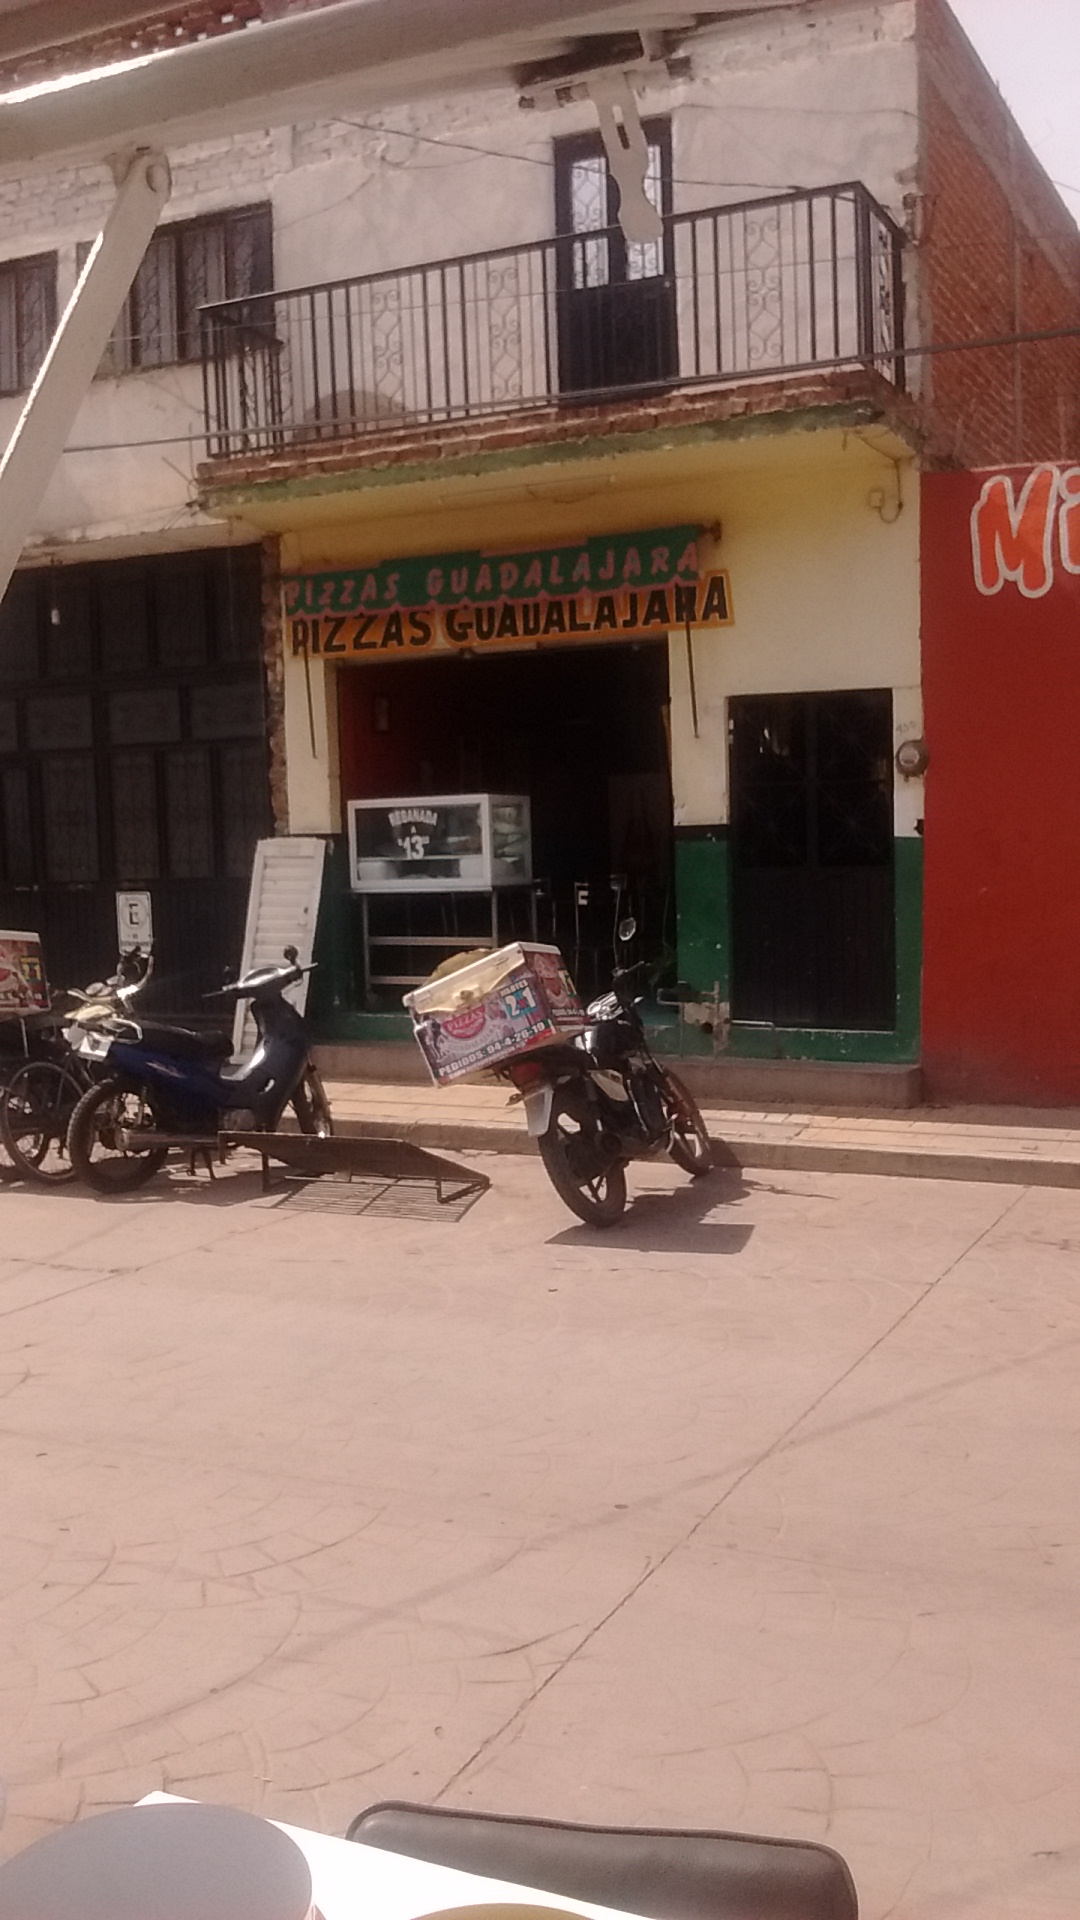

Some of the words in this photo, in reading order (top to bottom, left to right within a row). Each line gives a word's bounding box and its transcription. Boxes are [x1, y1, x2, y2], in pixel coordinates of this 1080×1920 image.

[286, 572, 400, 607] PIZZAS
[426, 542, 699, 596] GUADALAJARA
[292, 610, 432, 656] PIZZAS
[445, 576, 728, 642] GUADALAJARA
[388, 809, 438, 827] REBANADA
[411, 825, 417, 834] A
[128, 903, 140, 925] E
[446, 1009, 484, 1032] PIZZAS
[438, 1051, 486, 1077] PEDIDOS:
